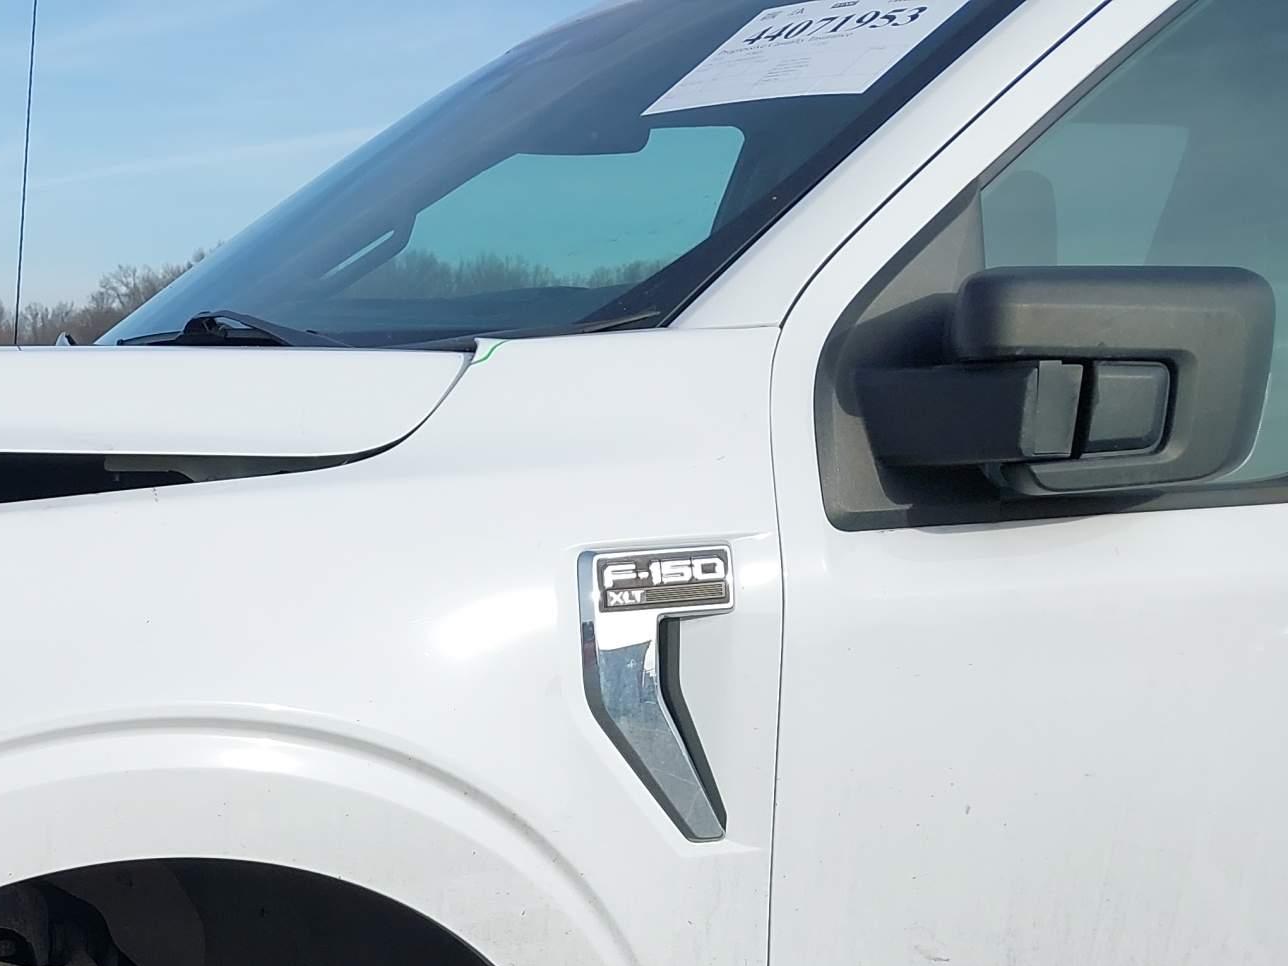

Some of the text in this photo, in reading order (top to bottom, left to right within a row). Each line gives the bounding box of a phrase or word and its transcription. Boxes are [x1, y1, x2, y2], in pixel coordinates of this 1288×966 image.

[743, 6, 928, 45] 44071953
[603, 556, 725, 589] F-150
[608, 589, 645, 606] XLT
